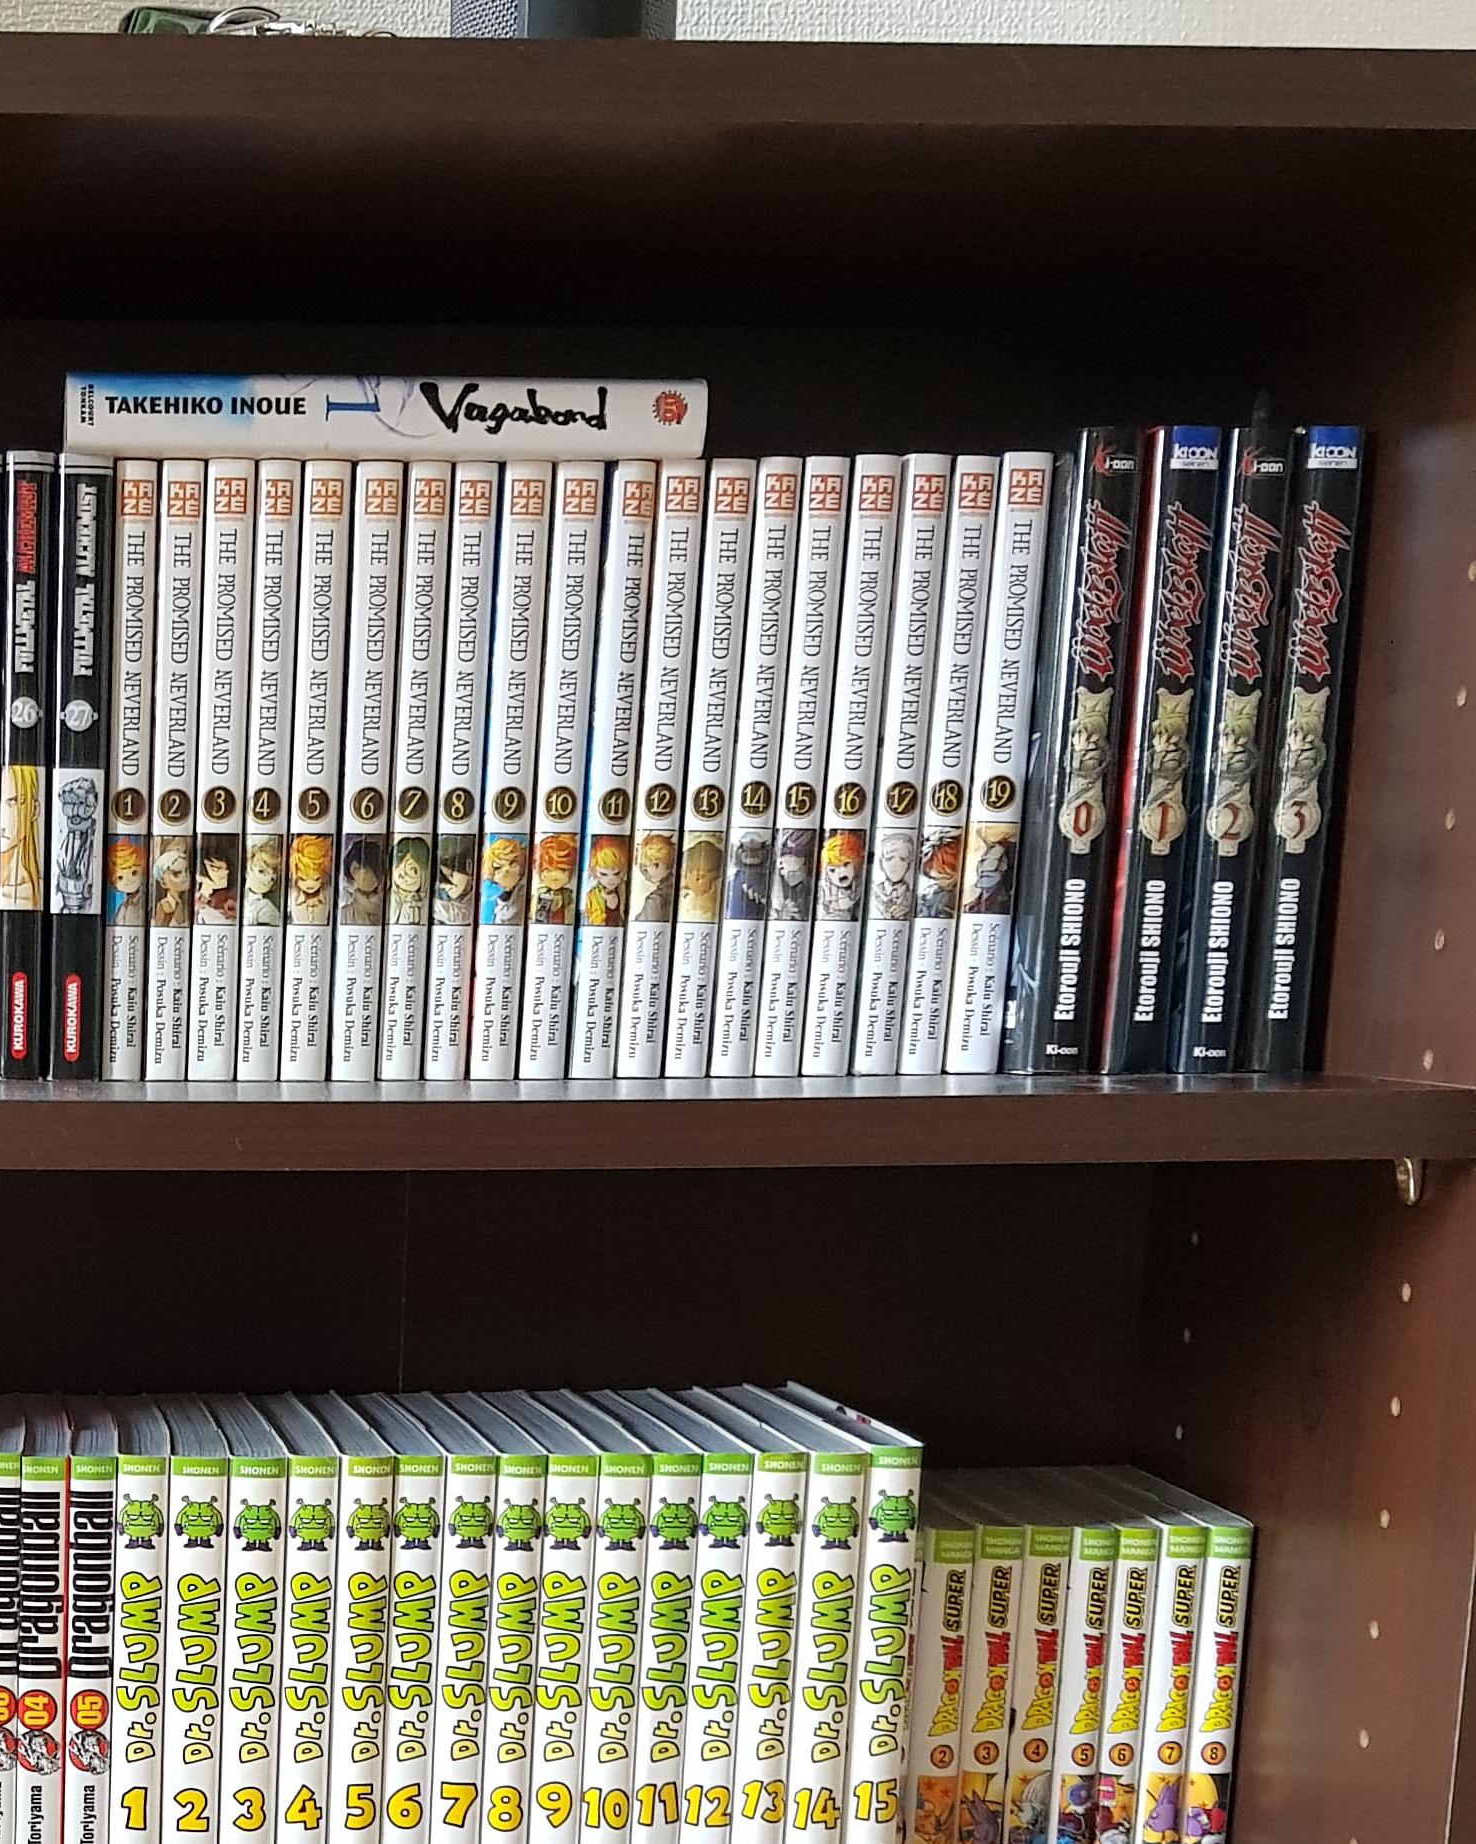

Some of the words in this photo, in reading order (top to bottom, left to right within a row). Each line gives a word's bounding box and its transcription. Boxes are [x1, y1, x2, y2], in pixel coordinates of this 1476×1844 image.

[105, 397, 222, 414] TAKEHIKO
[231, 397, 306, 415] INOUE
[419, 381, 607, 434] Vagabond
[128, 531, 145, 566] THE
[371, 530, 389, 565] THE
[1012, 520, 1032, 554] THE
[125, 576, 144, 662] PROMISED
[367, 575, 387, 661] PROMISED
[1004, 564, 1028, 650] PROMISED
[122, 671, 142, 776] NEVERLAND
[362, 670, 383, 775] NEVERLAND
[994, 658, 1020, 763] NEVERLAND
[122, 793, 135, 817] 1
[359, 792, 375, 819] 6
[547, 793, 571, 816] 10
[648, 791, 673, 814] 12
[838, 788, 860, 811] 16
[987, 783, 1011, 806] 19
[1074, 801, 1094, 837] 0
[1158, 801, 1169, 842] 1
[1220, 803, 1241, 840] 2
[1292, 800, 1307, 839] 3
[1061, 879, 1085, 946] SHIONO
[1275, 879, 1300, 945] SHIONO
[199, 977, 209, 1015] Posuka
[216, 987, 226, 1010] Kaiu
[1054, 950, 1080, 1019] Etorouji
[1268, 949, 1294, 1019] Etorouji
[66, 983, 77, 1052] KUROKAWA
[214, 1014, 226, 1047] Shirai
[197, 1020, 208, 1061] Demizu
[991, 1566, 1012, 1626] SUPER
[1217, 1565, 1241, 1625] SUPER
[983, 1747, 990, 1760] 3
[1118, 1748, 1126, 1761] 6
[1210, 1747, 1218, 1760] 8
[174, 1787, 211, 1832] 2
[439, 1781, 479, 1829] 7
[583, 1788, 629, 1832] 10
[854, 1778, 899, 1823] 15
